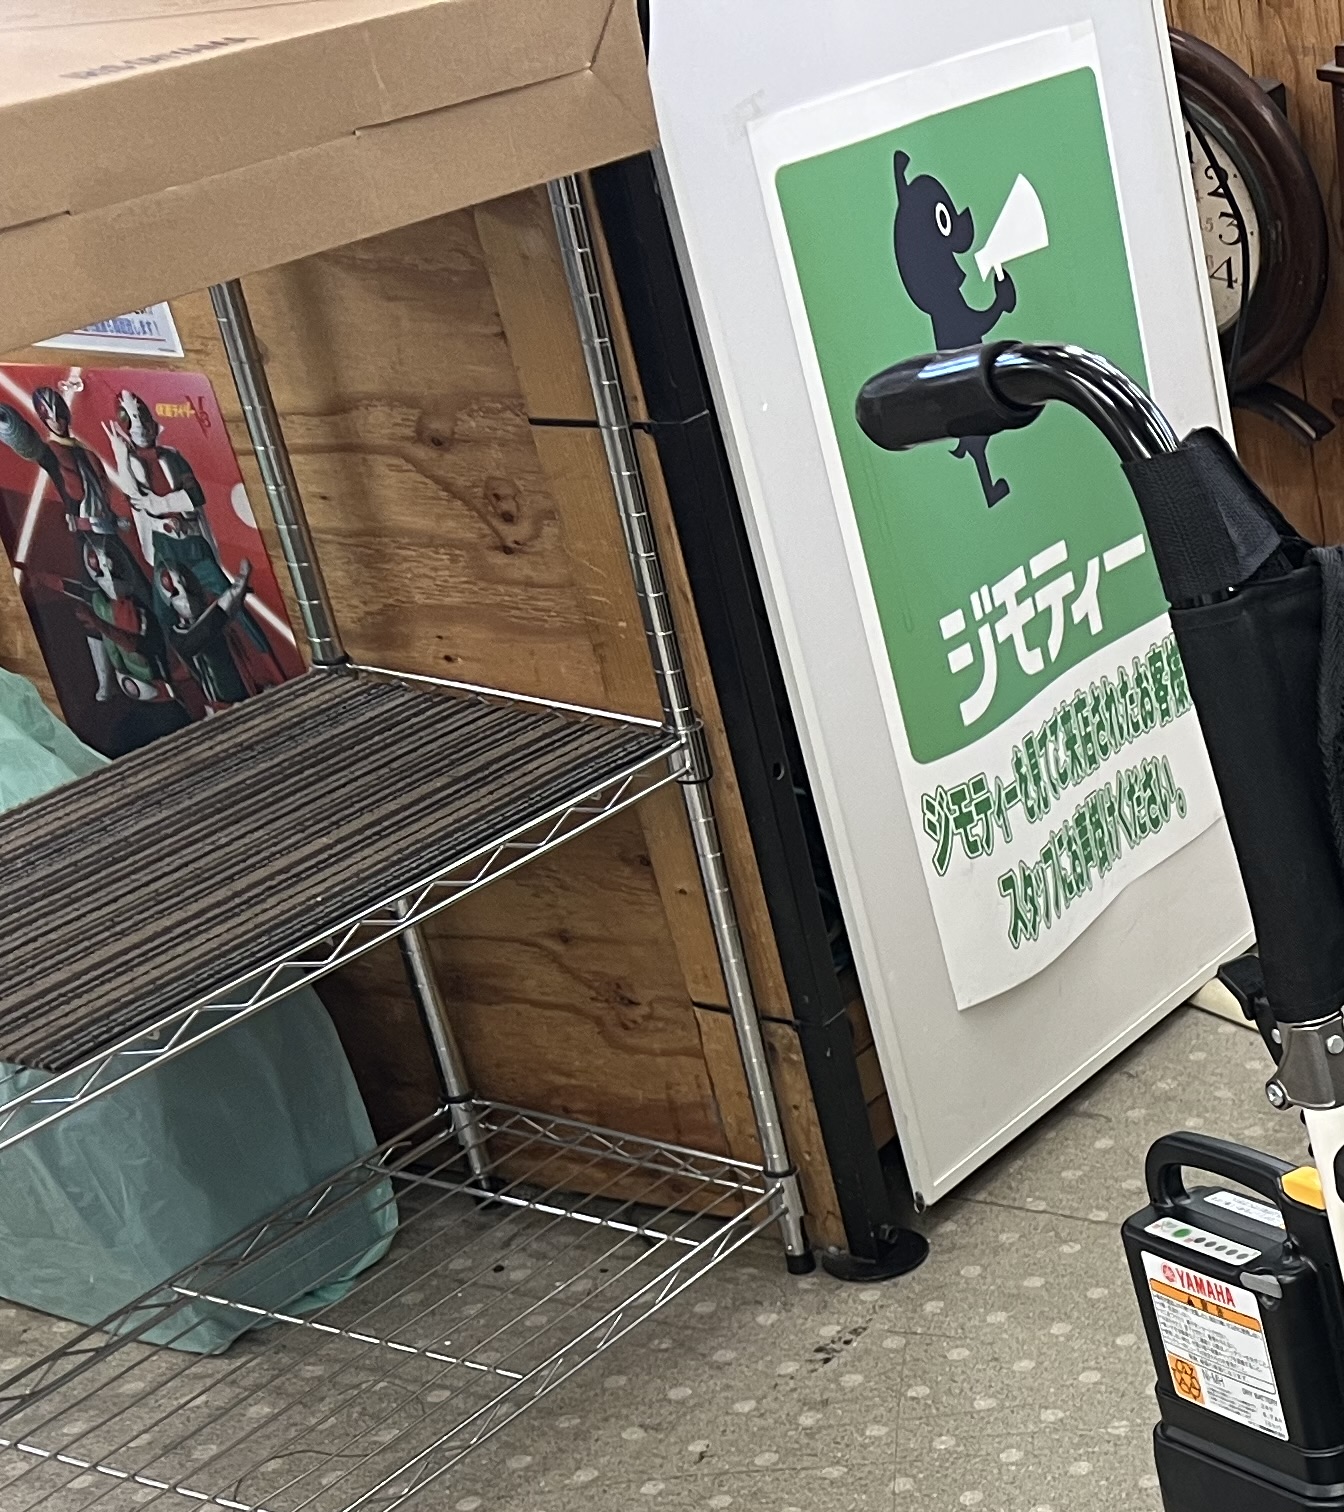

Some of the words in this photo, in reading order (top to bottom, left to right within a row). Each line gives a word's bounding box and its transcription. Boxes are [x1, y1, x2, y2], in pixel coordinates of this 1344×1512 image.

[1210, 256, 1238, 290] 4
[938, 533, 1146, 708] ジモティー
[1175, 1267, 1236, 1308] YAMAHA
